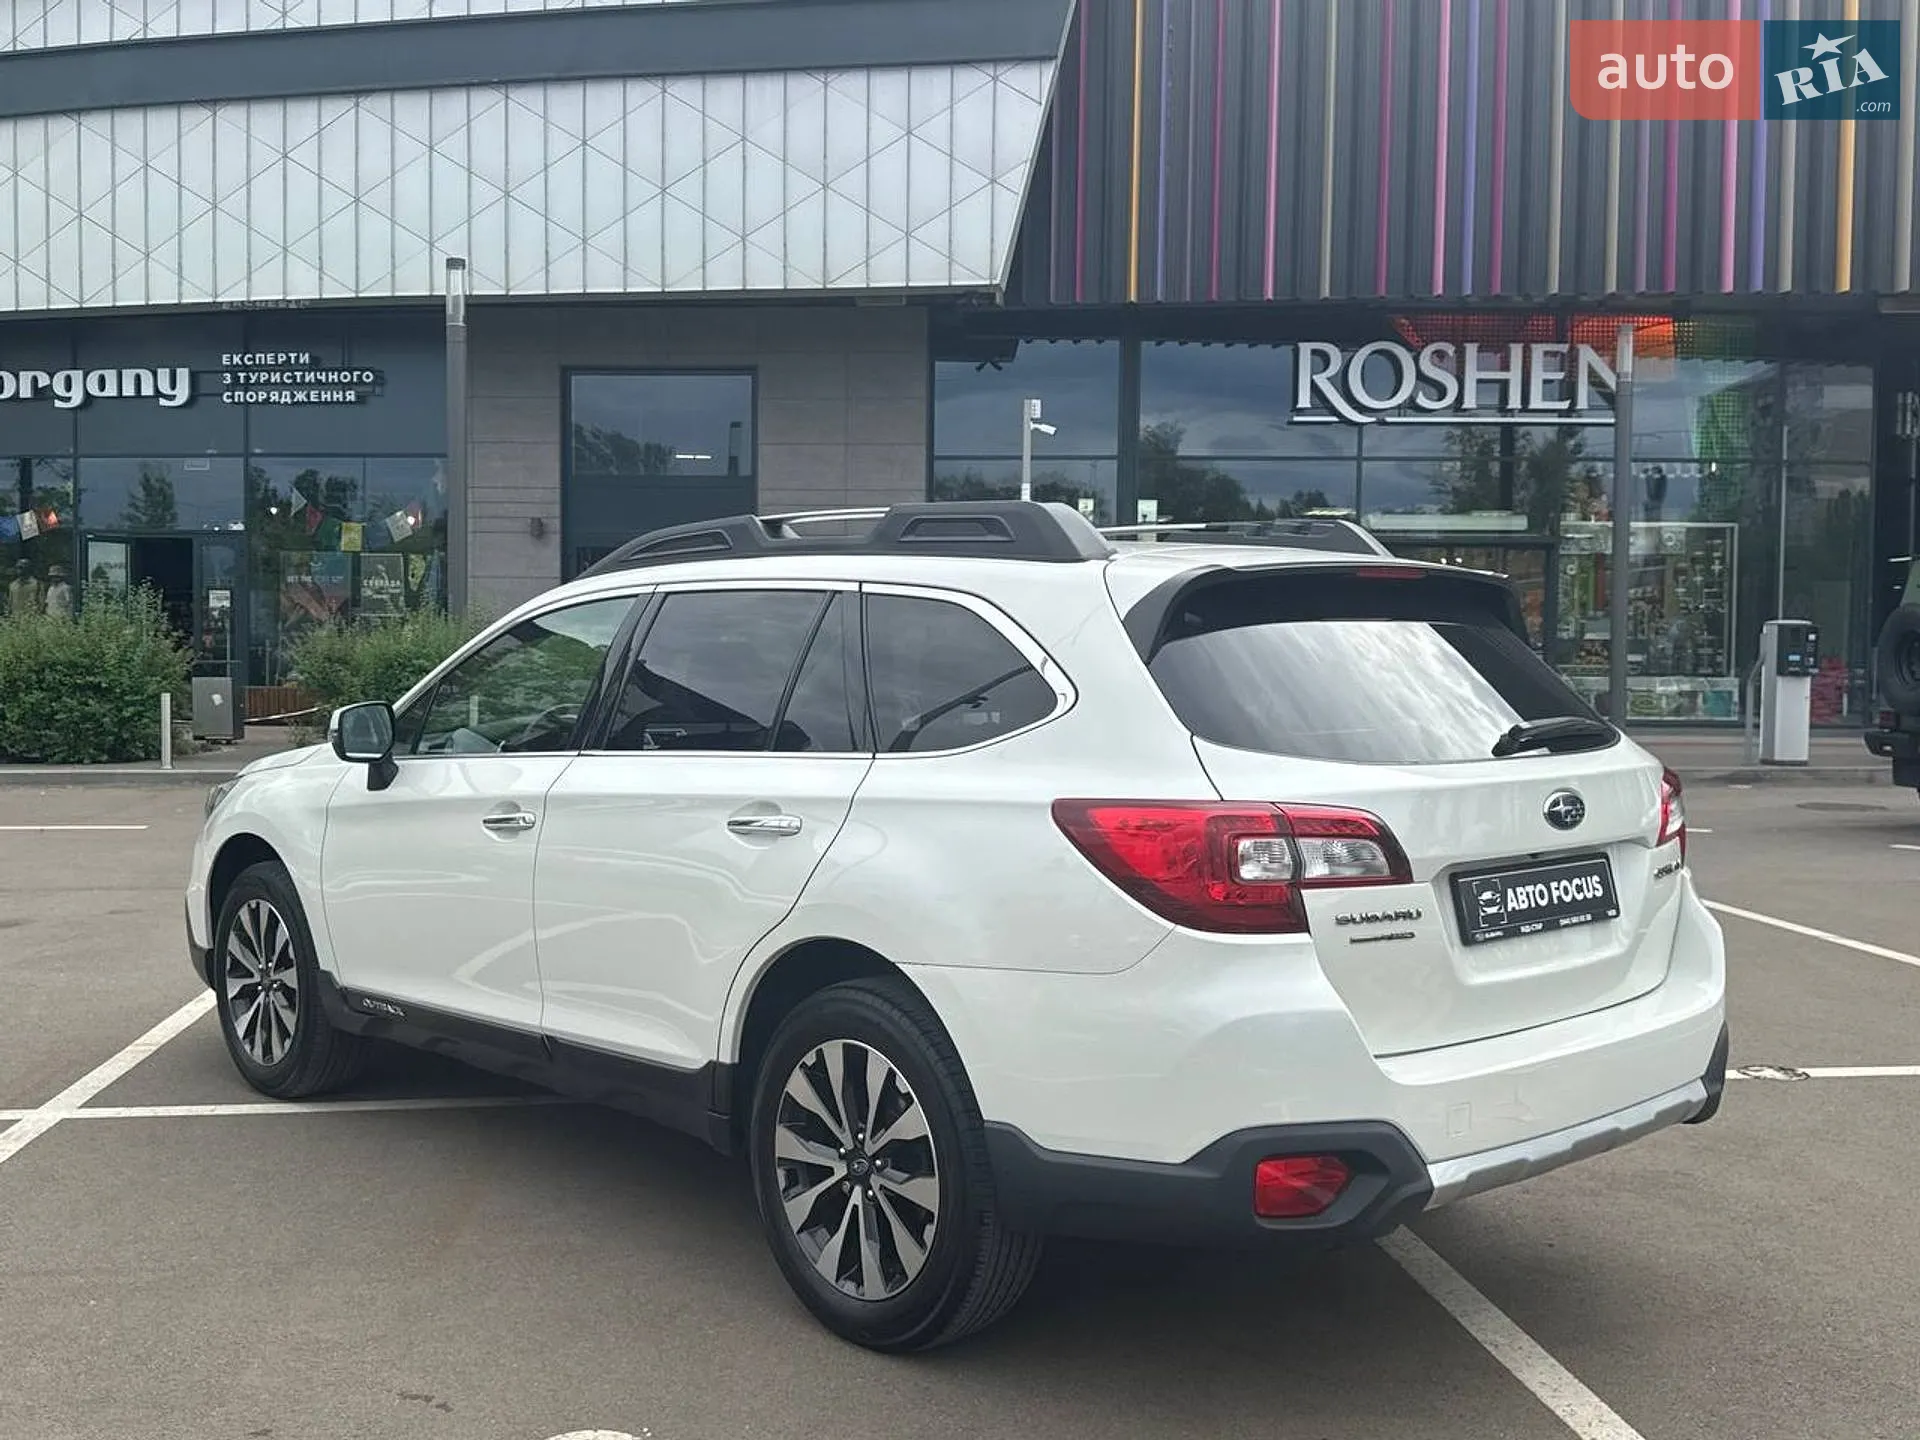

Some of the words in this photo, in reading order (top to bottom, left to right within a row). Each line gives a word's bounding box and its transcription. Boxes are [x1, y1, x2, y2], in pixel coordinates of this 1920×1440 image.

[222, 352, 311, 365] ЕКСПЕРТИ
[237, 371, 374, 384] ТУРИСТИЧНОГО
[1296, 340, 1618, 424] ROSHEN
[222, 390, 356, 404] СПОРЯДЖЕННЯ
[1550, 874, 1604, 905] FOCUS
